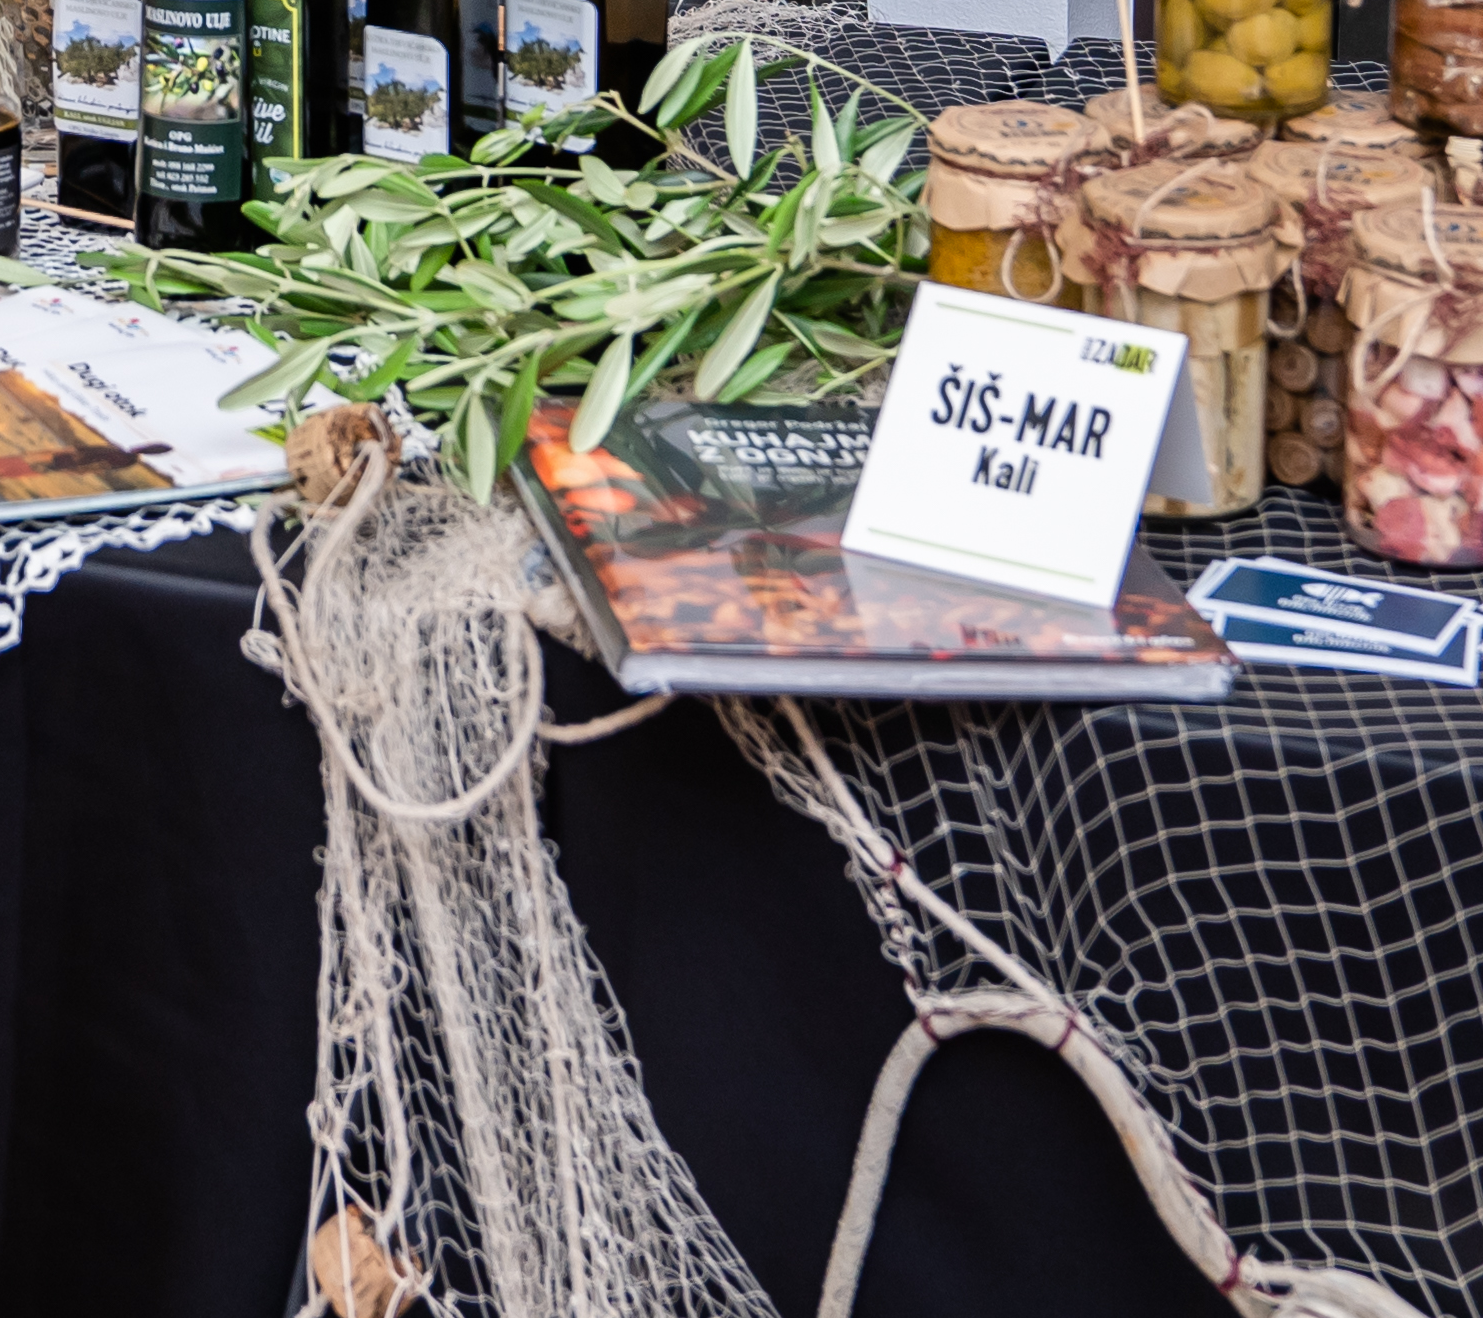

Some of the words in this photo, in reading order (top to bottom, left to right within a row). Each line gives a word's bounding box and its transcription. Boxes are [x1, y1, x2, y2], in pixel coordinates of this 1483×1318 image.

[145, 4, 203, 29] MASLINOVO
[205, 11, 232, 30] ULJE
[250, 25, 292, 44] OTINE
[253, 96, 286, 122] ive
[253, 121, 274, 145] il
[931, 363, 1112, 459] ŠIŠ-MAR
[686, 429, 872, 450] KUHAJM
[735, 446, 869, 467] OGNJ
[972, 445, 1040, 496] Kali
